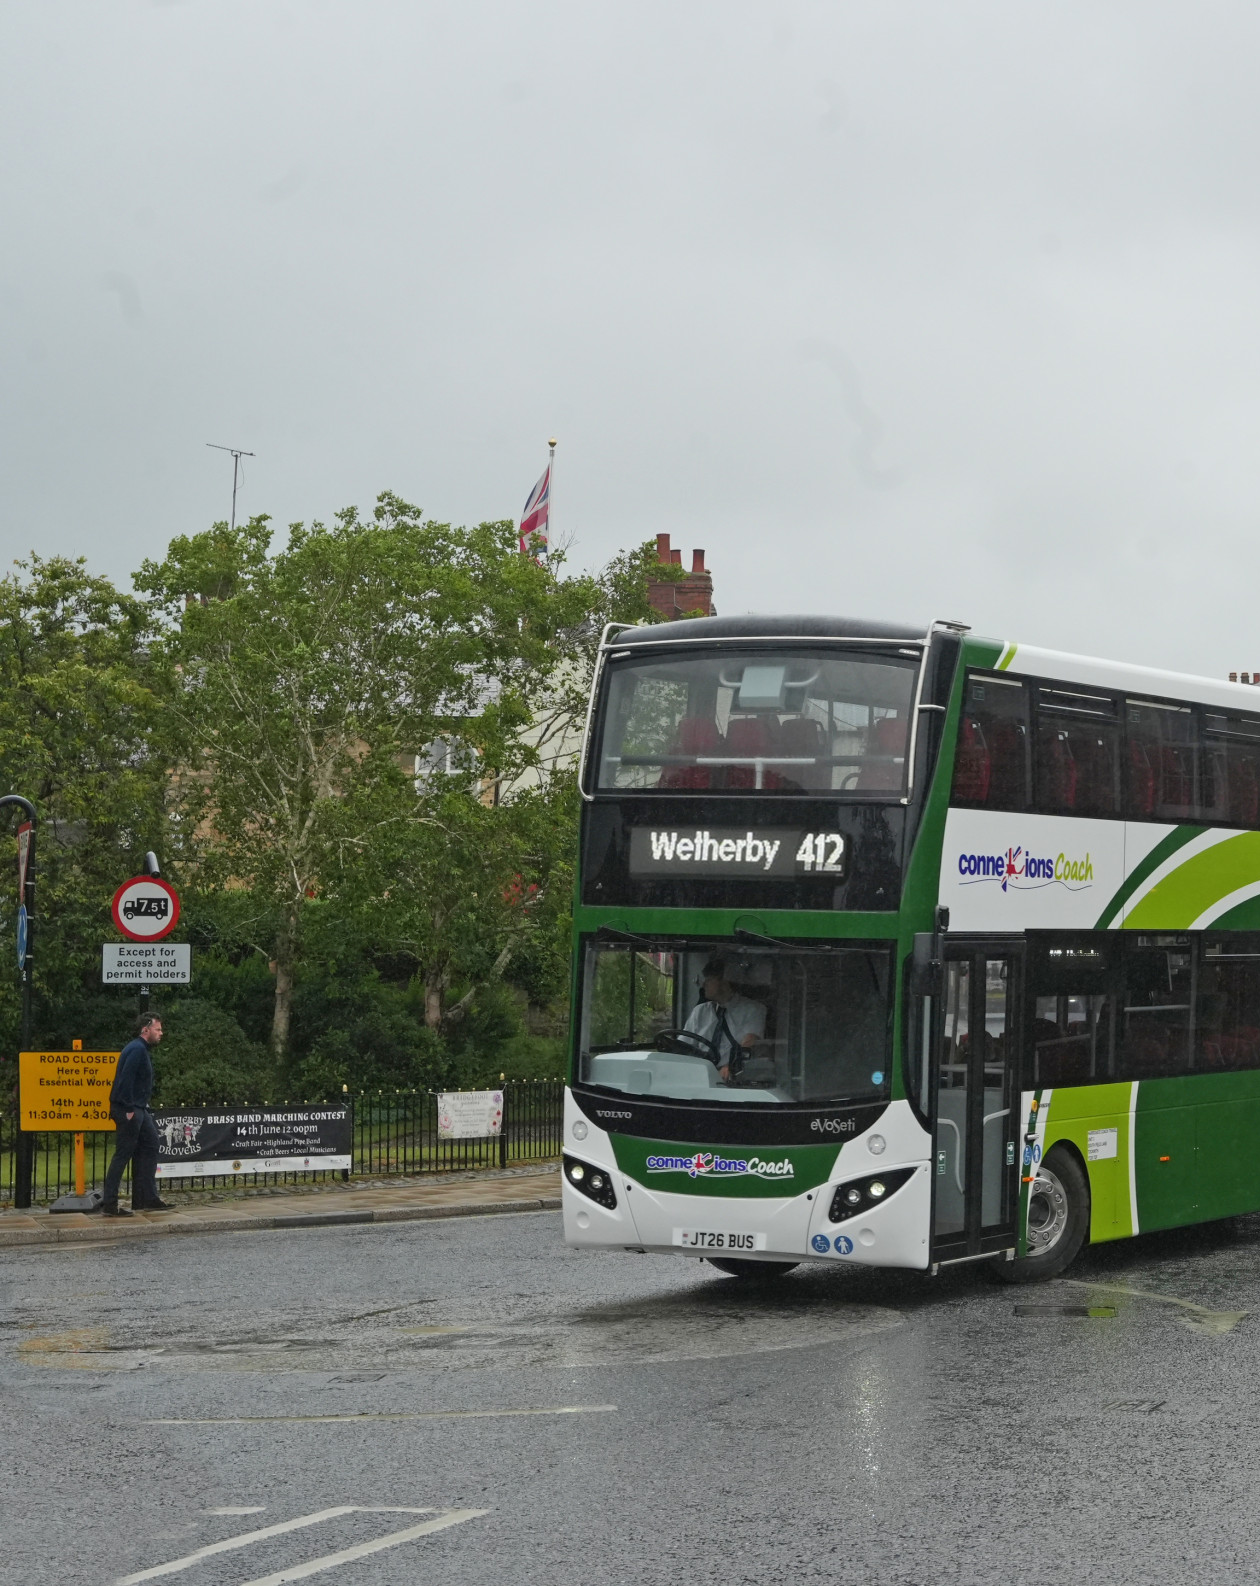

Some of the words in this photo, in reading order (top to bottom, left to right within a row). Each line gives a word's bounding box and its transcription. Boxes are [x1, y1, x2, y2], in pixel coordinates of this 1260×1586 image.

[650, 831, 781, 870] Wetherby
[796, 833, 845, 872] 412
[1054, 852, 1094, 881] Coach
[119, 947, 156, 957] Except
[160, 947, 176, 956] for
[157, 959, 176, 967] and
[106, 970, 143, 980] permit
[146, 969, 187, 979] holders
[40, 1055, 70, 1064] ROAD
[73, 1055, 116, 1064] CLOSED
[57, 1067, 80, 1075] Here
[83, 1067, 99, 1075] For
[39, 1078, 83, 1086] Essential
[87, 1078, 114, 1086] Work
[51, 1098, 74, 1107] 14th
[77, 1098, 102, 1107] June
[28, 1110, 72, 1119] 11:30am
[82, 1110, 113, 1120] 4:30
[207, 1115, 235, 1124] BRASS
[236, 1113, 261, 1123] BAND
[262, 1112, 309, 1122] MARCHING
[310, 1111, 347, 1121] CONTEST
[596, 1109, 632, 1119] VOLVO
[155, 1116, 205, 1127] WETHERBY
[810, 1117, 856, 1133] eVoSeti
[259, 1125, 281, 1136] June
[282, 1124, 318, 1136] 12.00pm
[235, 1140, 250, 1148] Craft
[266, 1139, 293, 1147] Highland
[294, 1138, 306, 1146] Pipe
[158, 1143, 202, 1156] DROVERS
[747, 1157, 794, 1175] Coach
[690, 1232, 725, 1248] JT26
[728, 1233, 754, 1249] BUS
